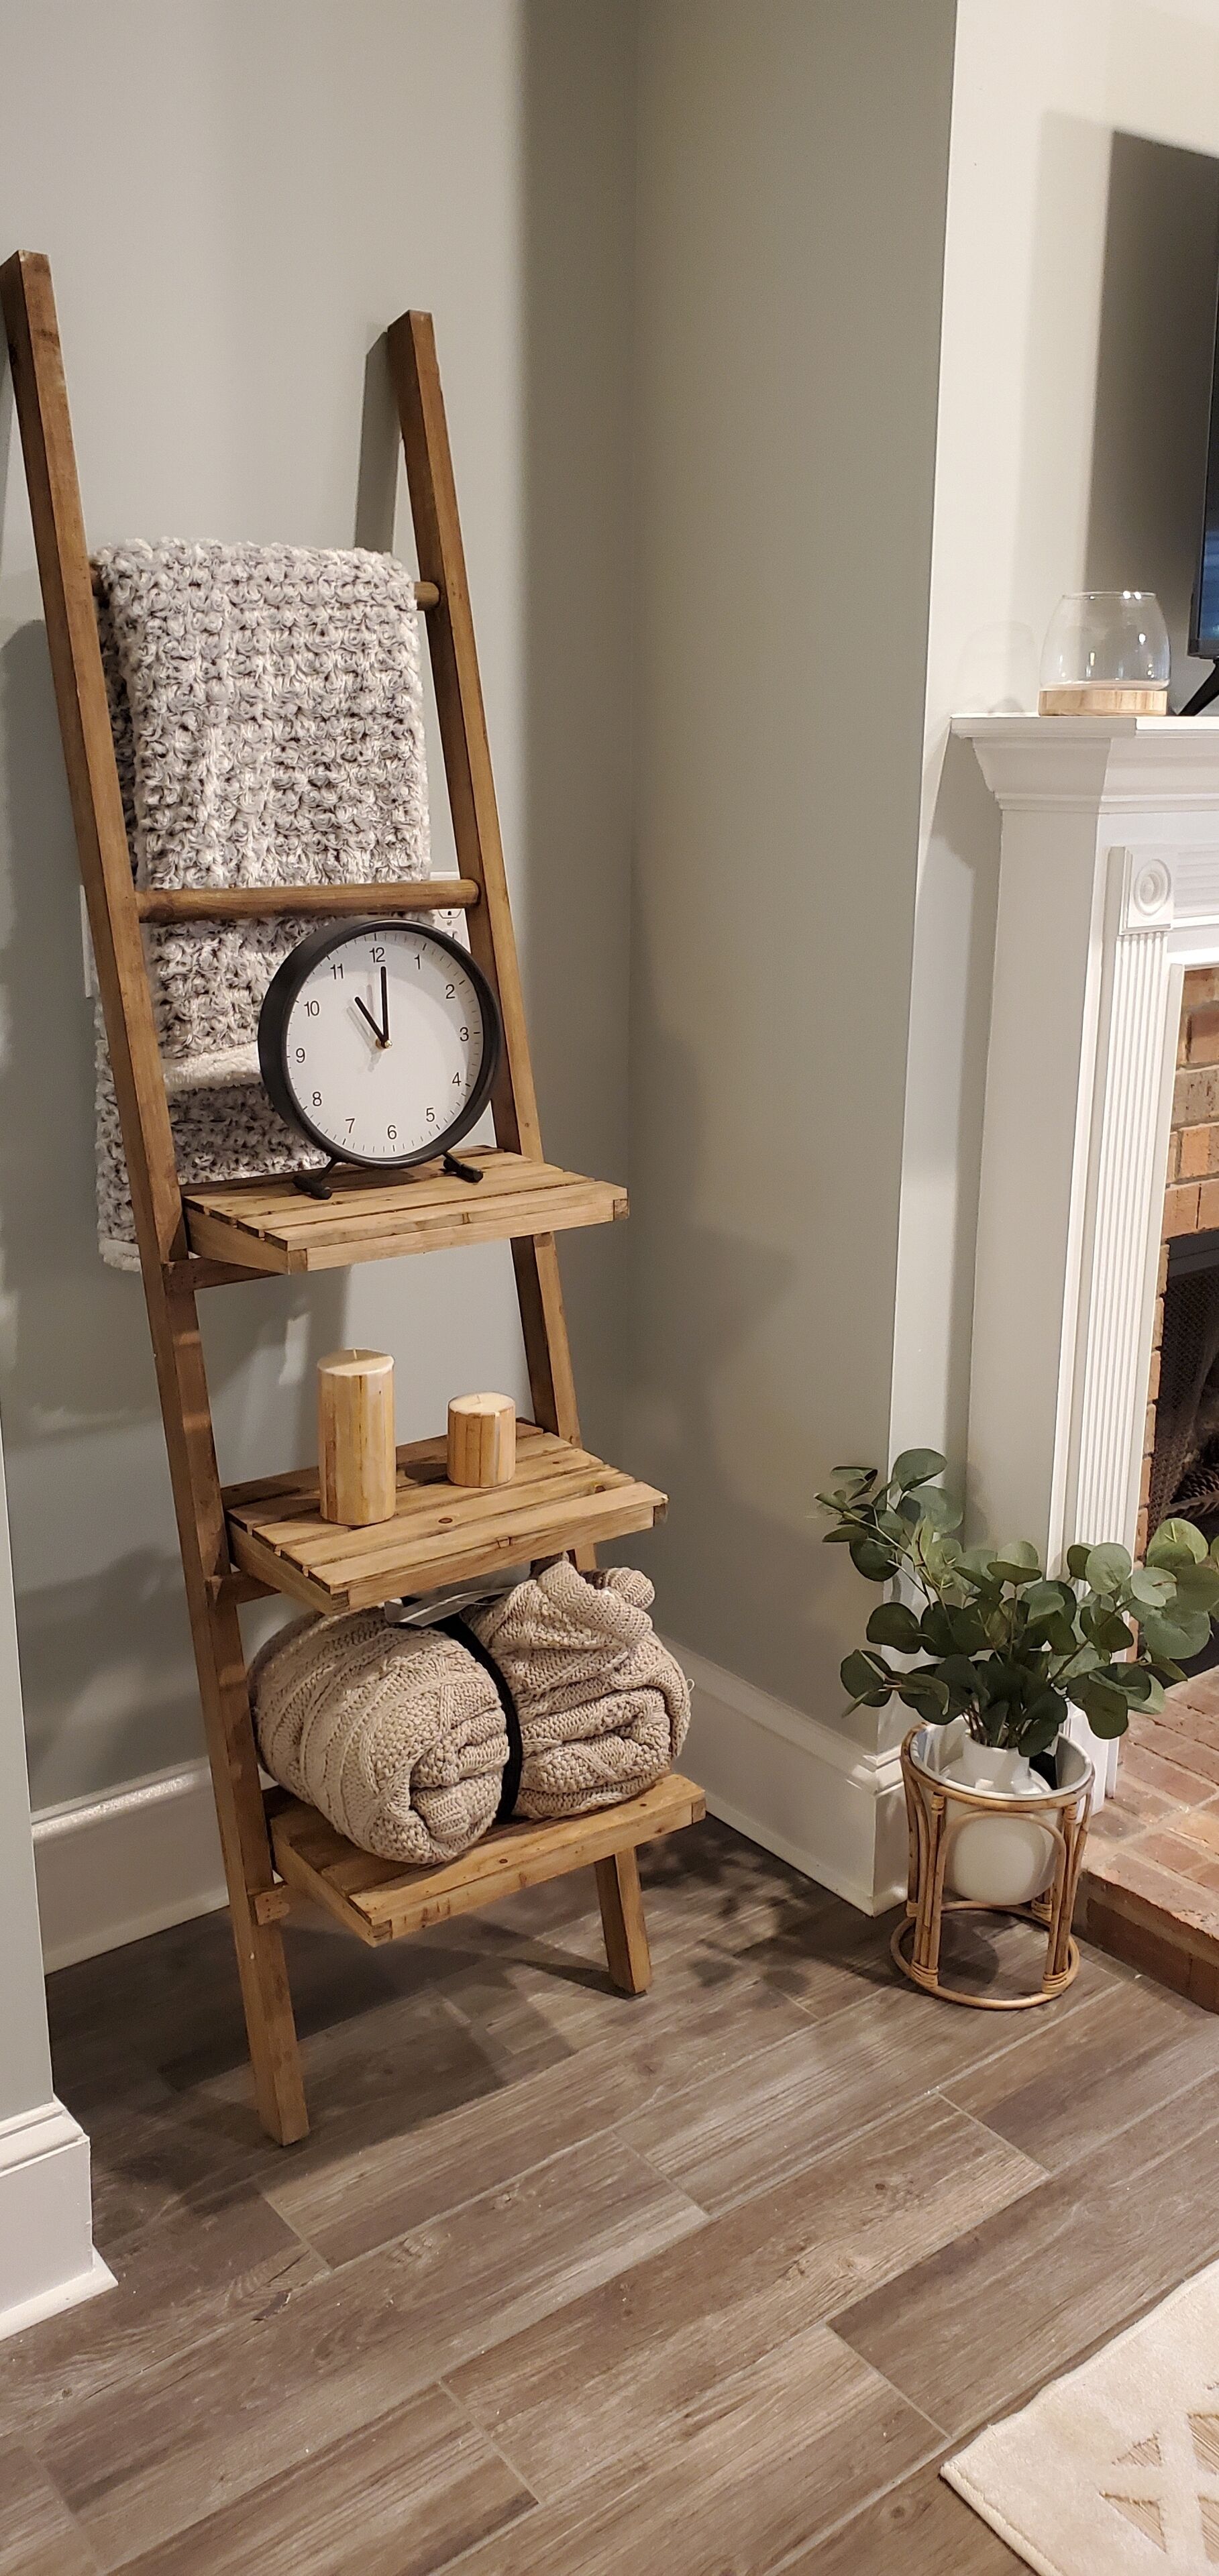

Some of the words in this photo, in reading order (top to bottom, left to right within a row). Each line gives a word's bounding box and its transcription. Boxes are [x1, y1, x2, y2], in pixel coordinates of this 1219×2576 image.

[369, 947, 386, 963] 12
[414, 954, 421, 970] 1
[330, 963, 343, 979] 11
[445, 983, 456, 1000] 2
[304, 1000, 320, 1017] 10
[460, 1026, 470, 1042] 3
[295, 1047, 305, 1063] 9
[452, 1072, 462, 1087] 4
[312, 1091, 322, 1107] 8
[426, 1107, 435, 1122] 5
[345, 1118, 355, 1134] 7
[387, 1124, 397, 1140] 6
